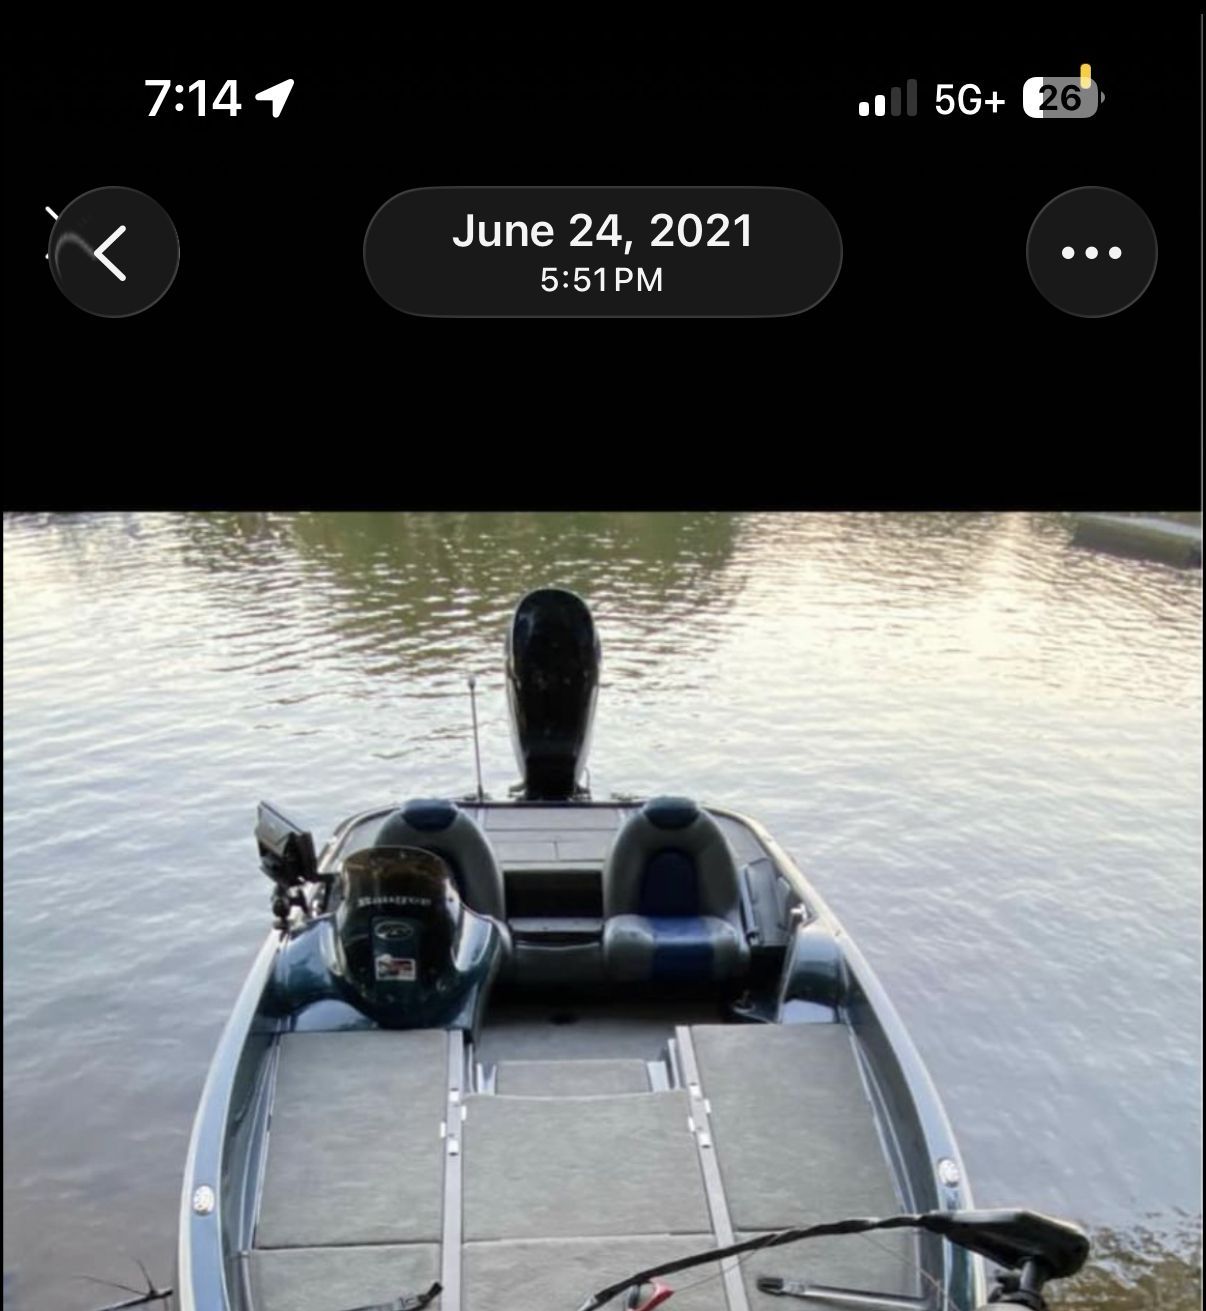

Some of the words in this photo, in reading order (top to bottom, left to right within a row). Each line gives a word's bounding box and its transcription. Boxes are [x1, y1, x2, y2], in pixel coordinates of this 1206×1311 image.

[144, 79, 242, 117] 7:14
[935, 83, 1006, 115] 5G+
[1038, 84, 1082, 111] 26
[452, 213, 554, 247] June
[569, 213, 633, 255] 24,
[650, 213, 750, 247] 2021
[540, 267, 605, 292] 5:51
[615, 267, 663, 292] PM
